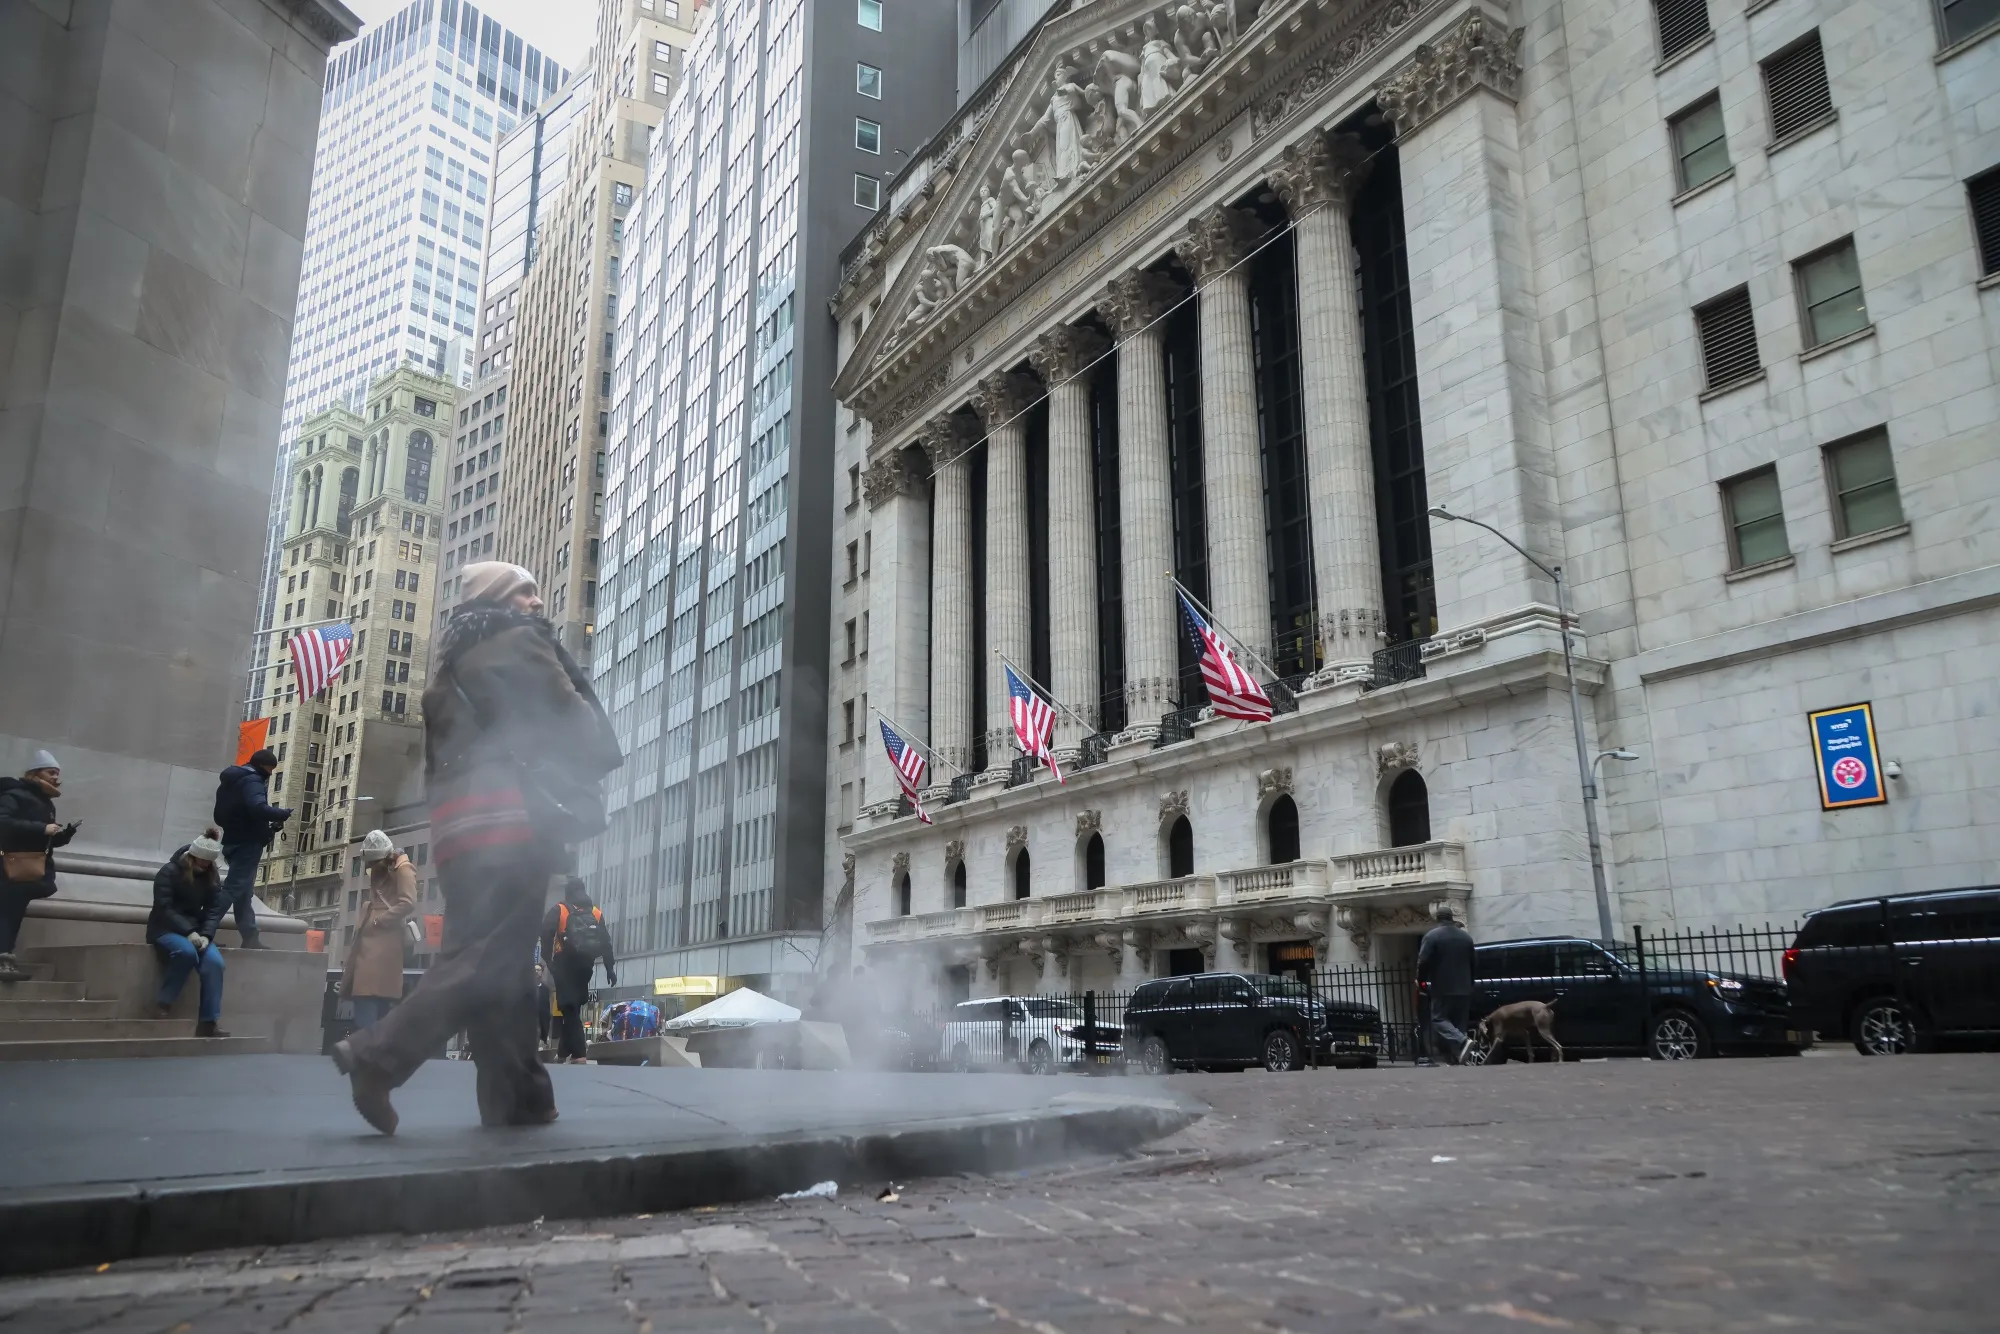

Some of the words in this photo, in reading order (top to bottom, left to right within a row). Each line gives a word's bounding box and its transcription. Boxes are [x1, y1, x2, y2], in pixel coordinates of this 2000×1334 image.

[984, 316, 1011, 351] NEW
[1018, 283, 1053, 324] YORK
[1060, 241, 1105, 289] STOCK
[1114, 164, 1203, 249] EXCHANGE
